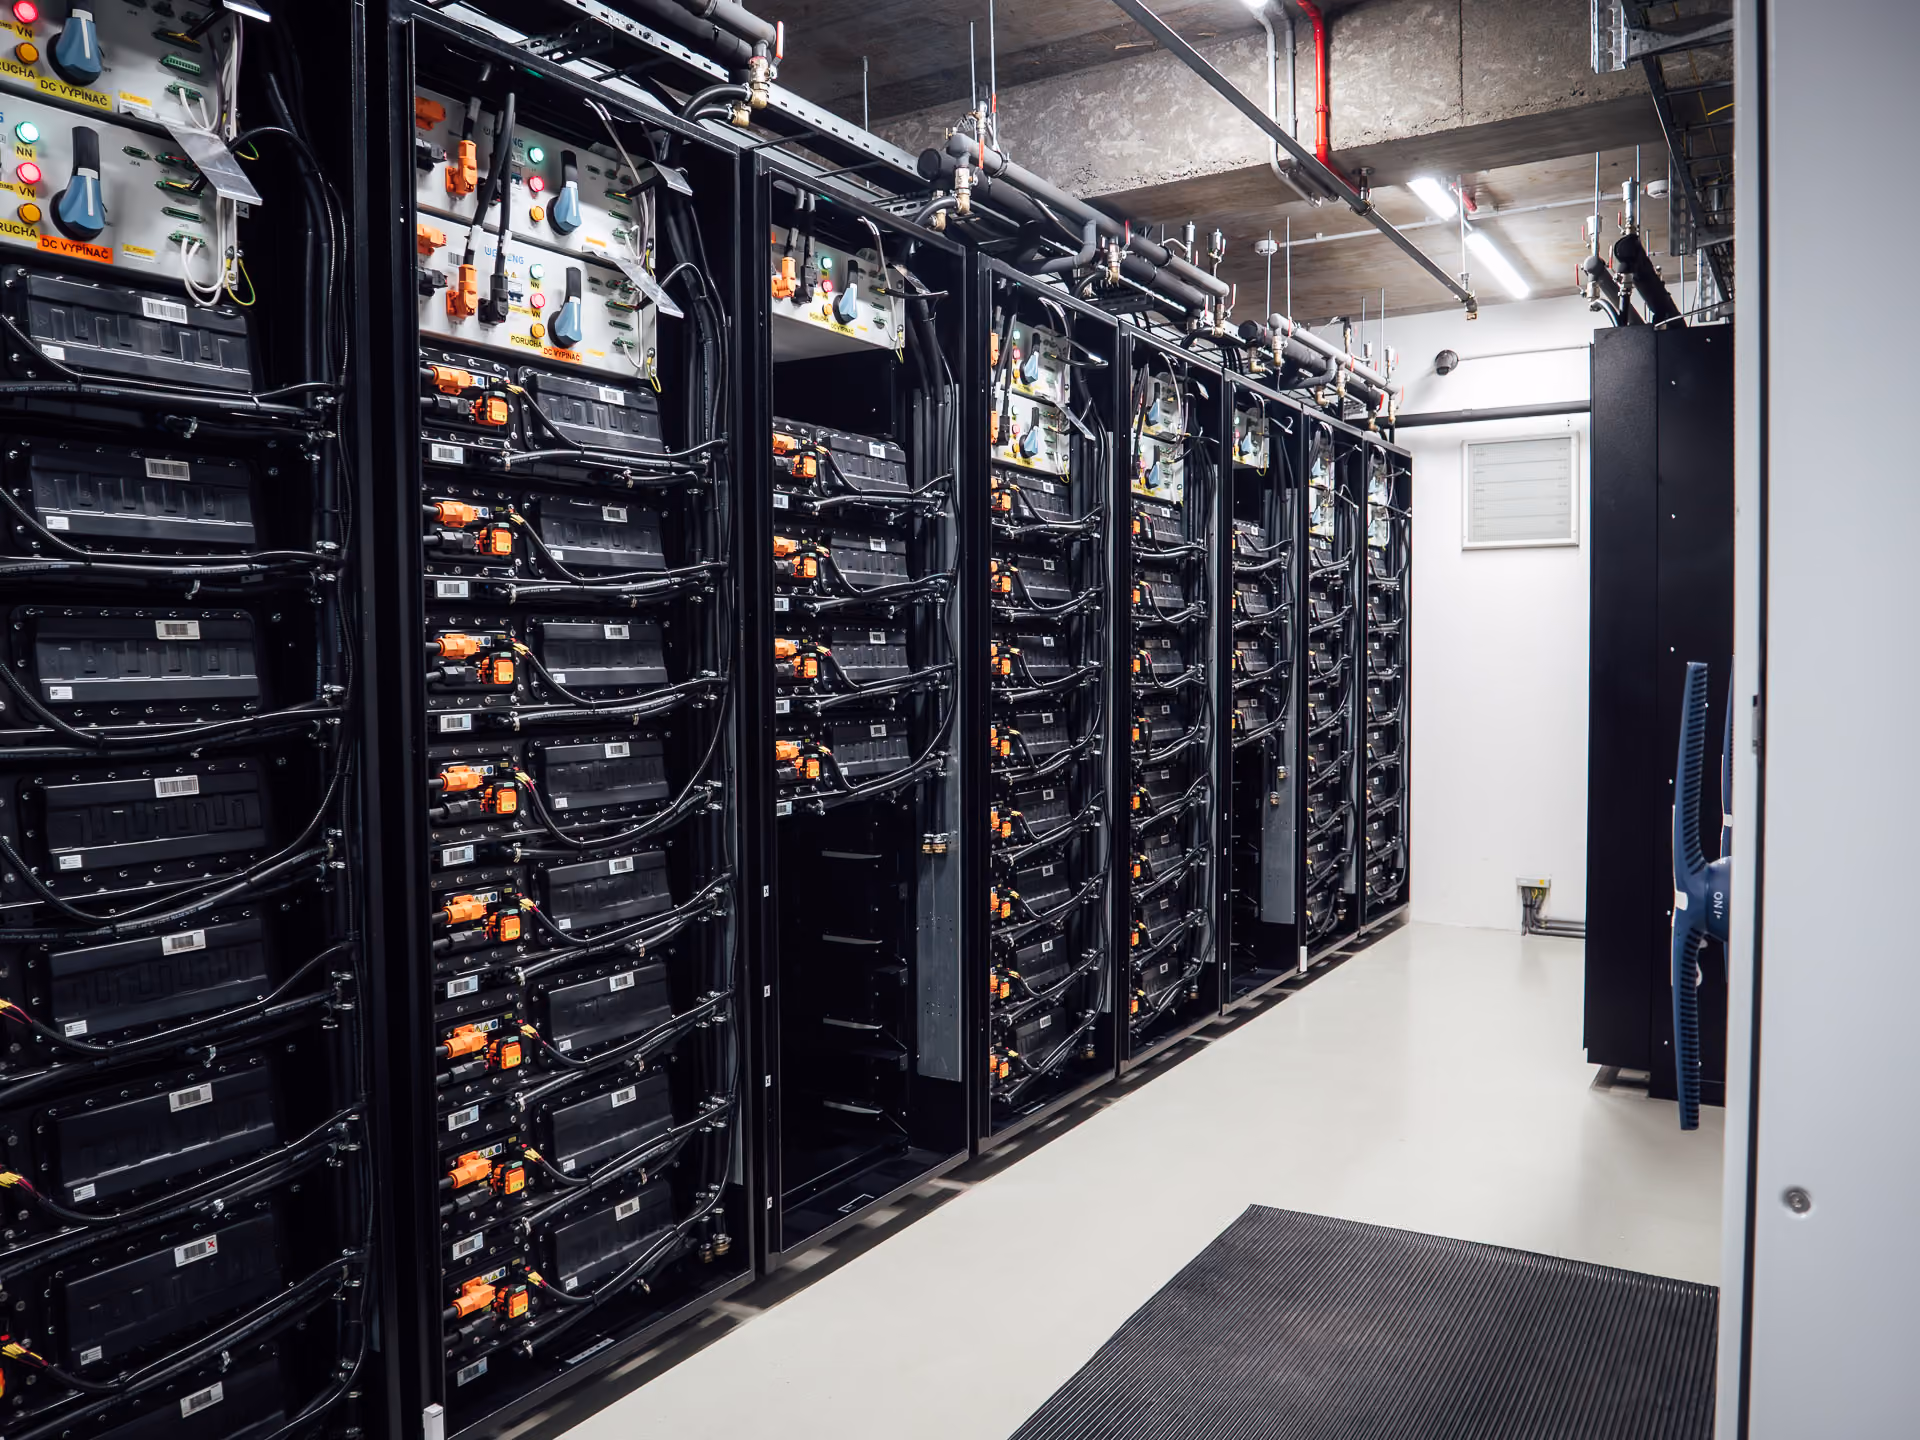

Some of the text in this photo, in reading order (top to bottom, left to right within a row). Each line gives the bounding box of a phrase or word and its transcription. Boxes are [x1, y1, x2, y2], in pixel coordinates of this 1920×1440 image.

[17, 25, 33, 39] VN
[0, 61, 35, 80] UCHA
[41, 80, 56, 91] DC
[16, 146, 33, 158] NN
[19, 186, 35, 198] VN
[42, 237, 57, 249] DC
[531, 281, 540, 289] NN
[543, 347, 552, 356] DC
